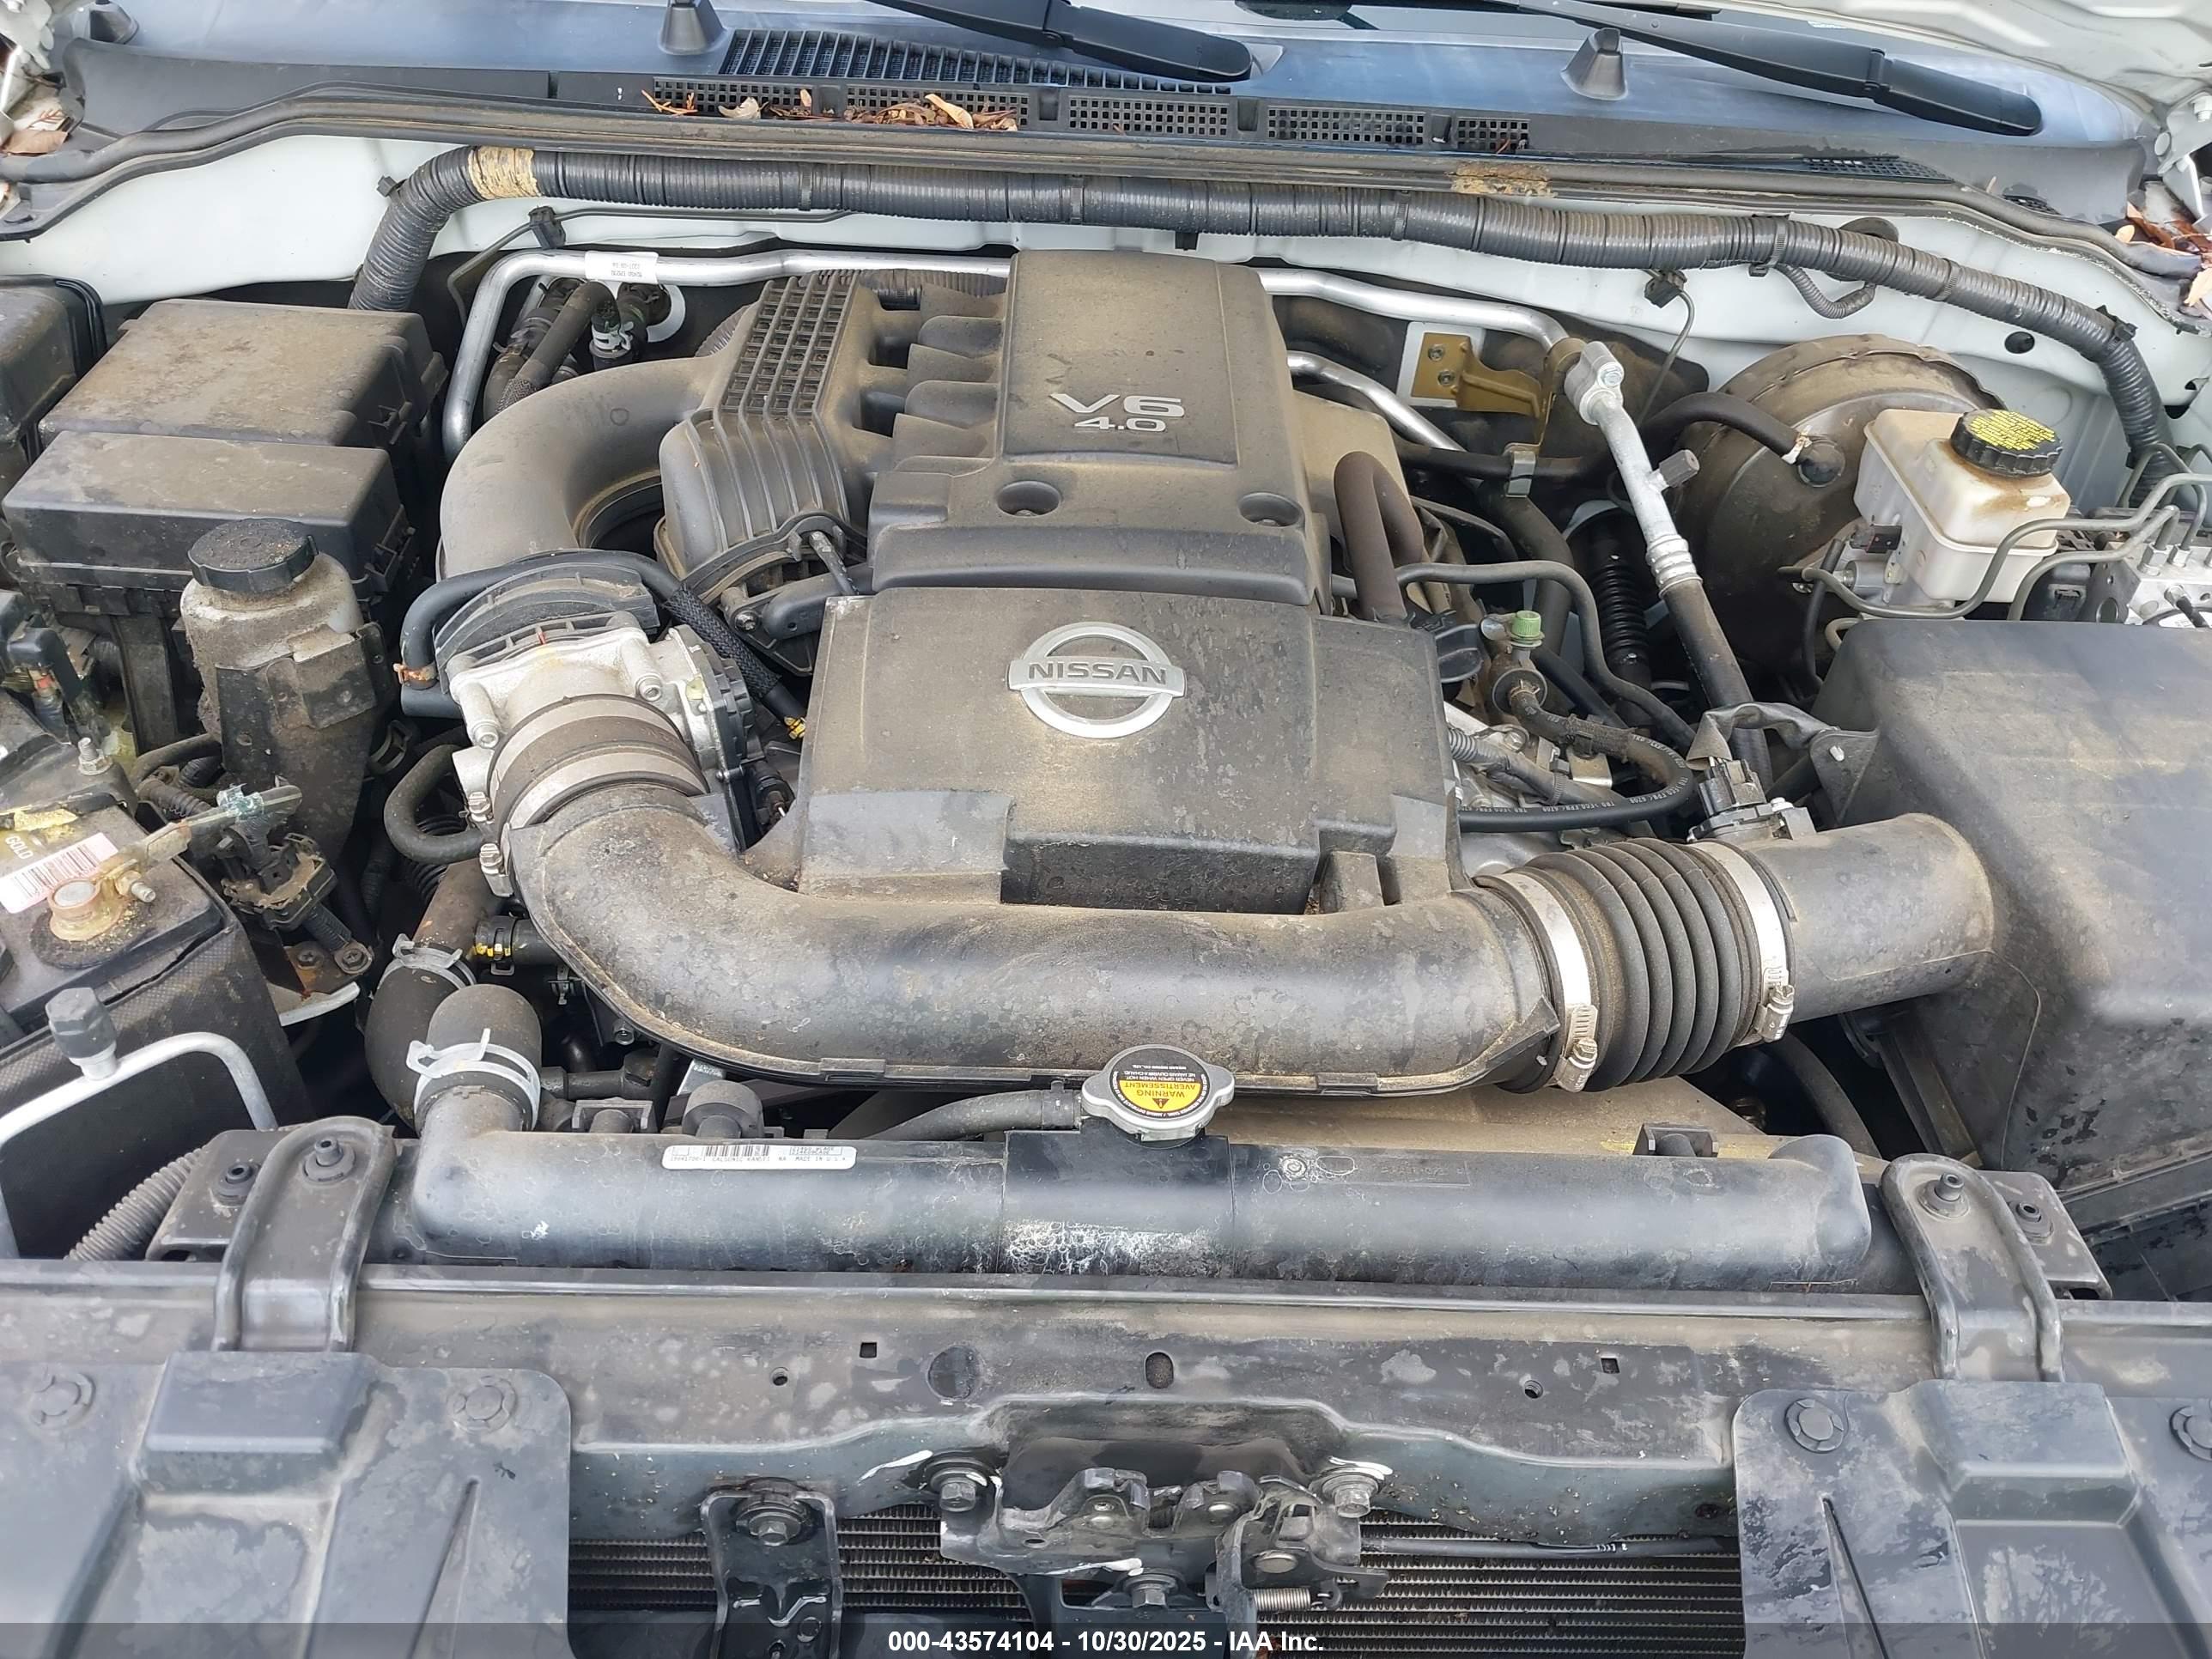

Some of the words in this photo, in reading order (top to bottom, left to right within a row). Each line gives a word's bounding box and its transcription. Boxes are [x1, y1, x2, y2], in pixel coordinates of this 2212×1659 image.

[1048, 393, 1185, 417] V6
[1074, 416, 1166, 432] 4.0
[1029, 662, 1167, 684] NISSAN
[4, 835, 34, 860] GOLD
